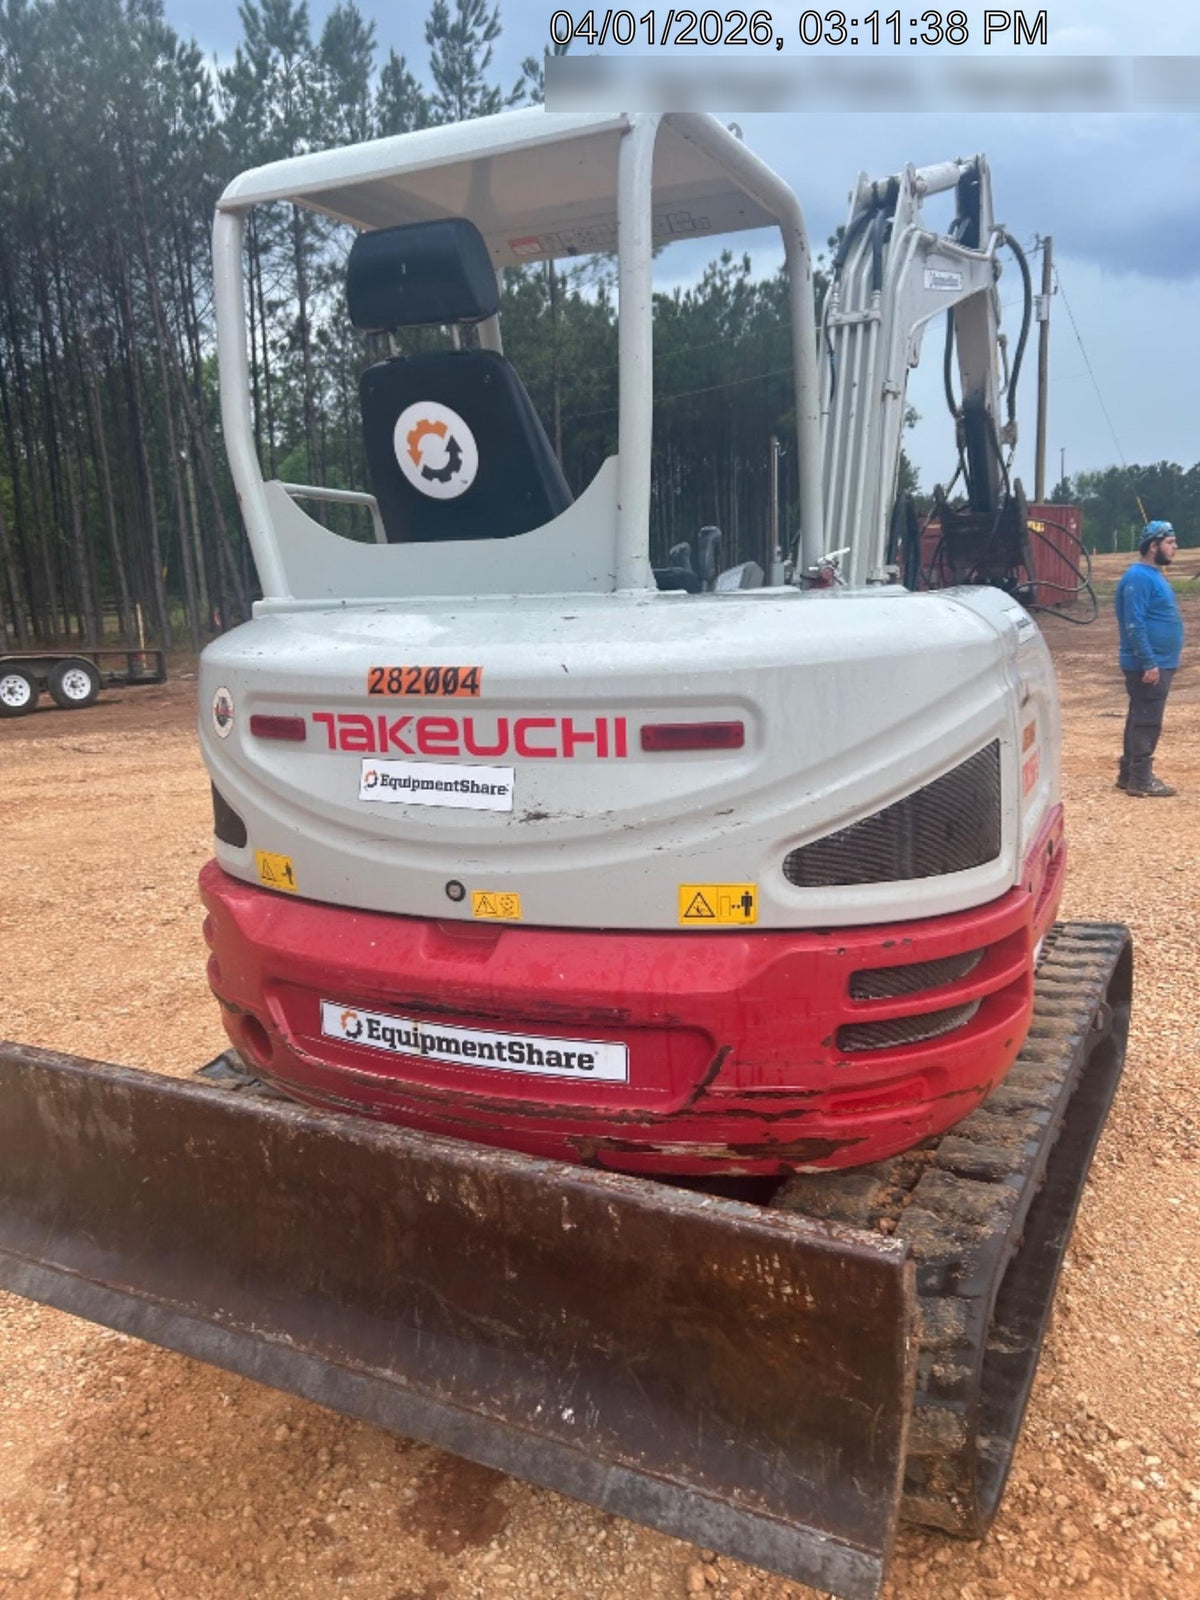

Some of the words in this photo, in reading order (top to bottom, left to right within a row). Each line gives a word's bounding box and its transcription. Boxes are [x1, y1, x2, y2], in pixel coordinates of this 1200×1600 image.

[369, 667, 480, 695] 282004
[379, 772, 510, 797] EquipmentShare
[365, 1017, 597, 1072] EquipmentShare
